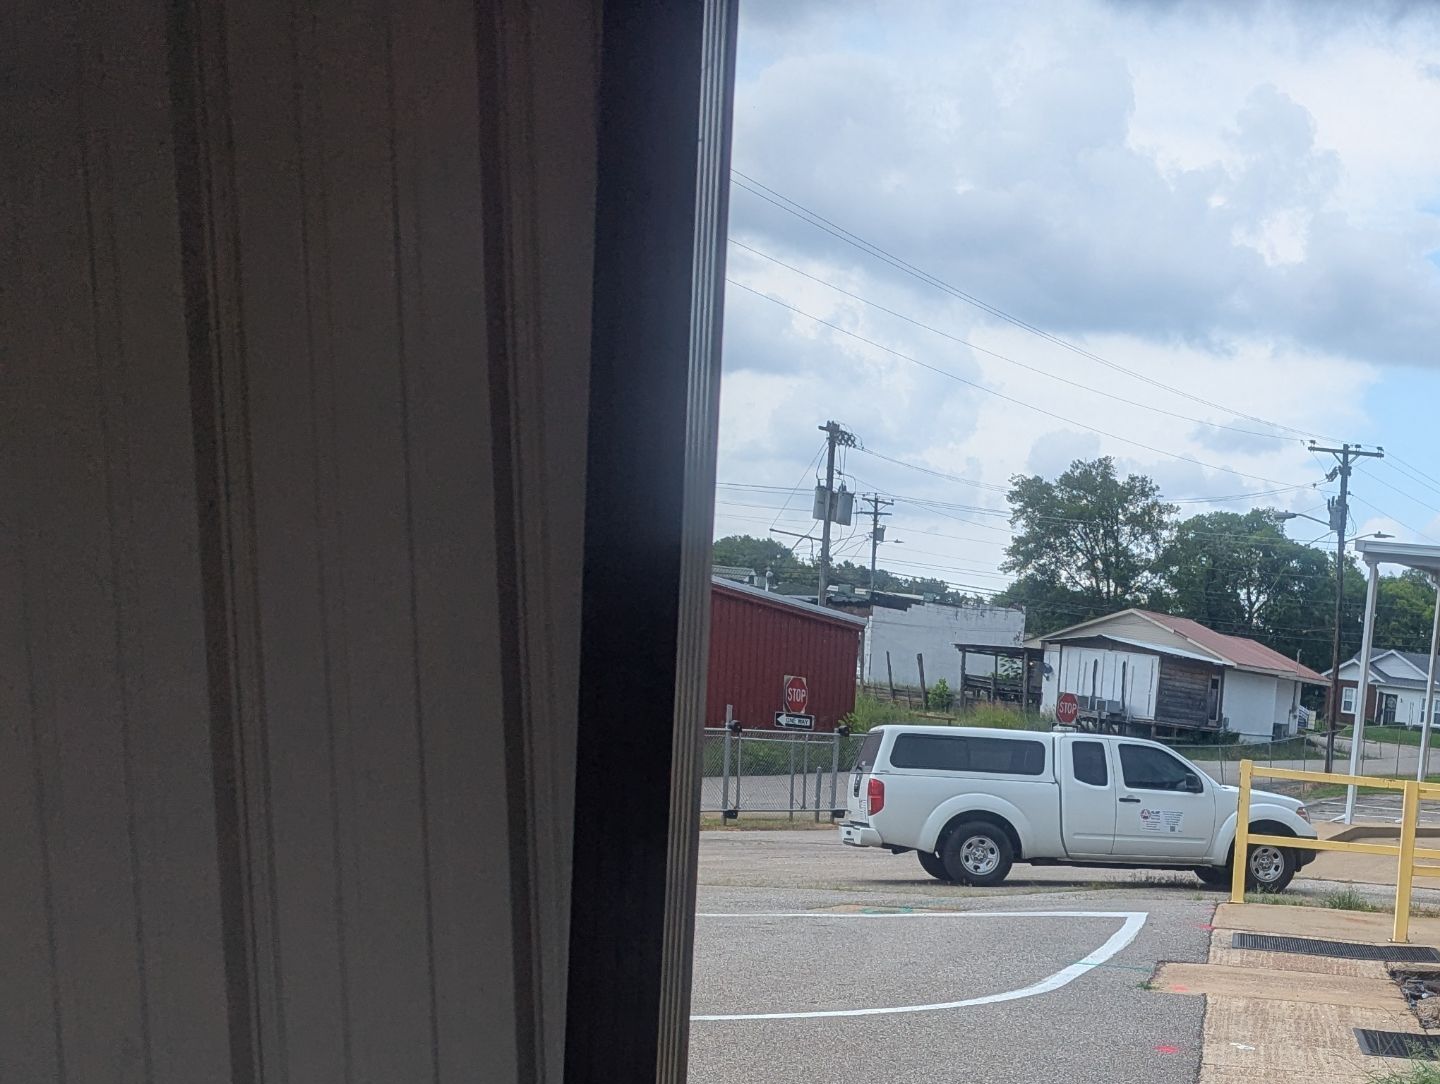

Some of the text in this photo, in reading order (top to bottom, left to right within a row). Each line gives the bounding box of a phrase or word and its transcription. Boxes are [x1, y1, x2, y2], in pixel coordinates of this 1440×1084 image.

[787, 687, 806, 703] STOP
[1059, 702, 1077, 715] STOP
[797, 718, 809, 726] WAY
